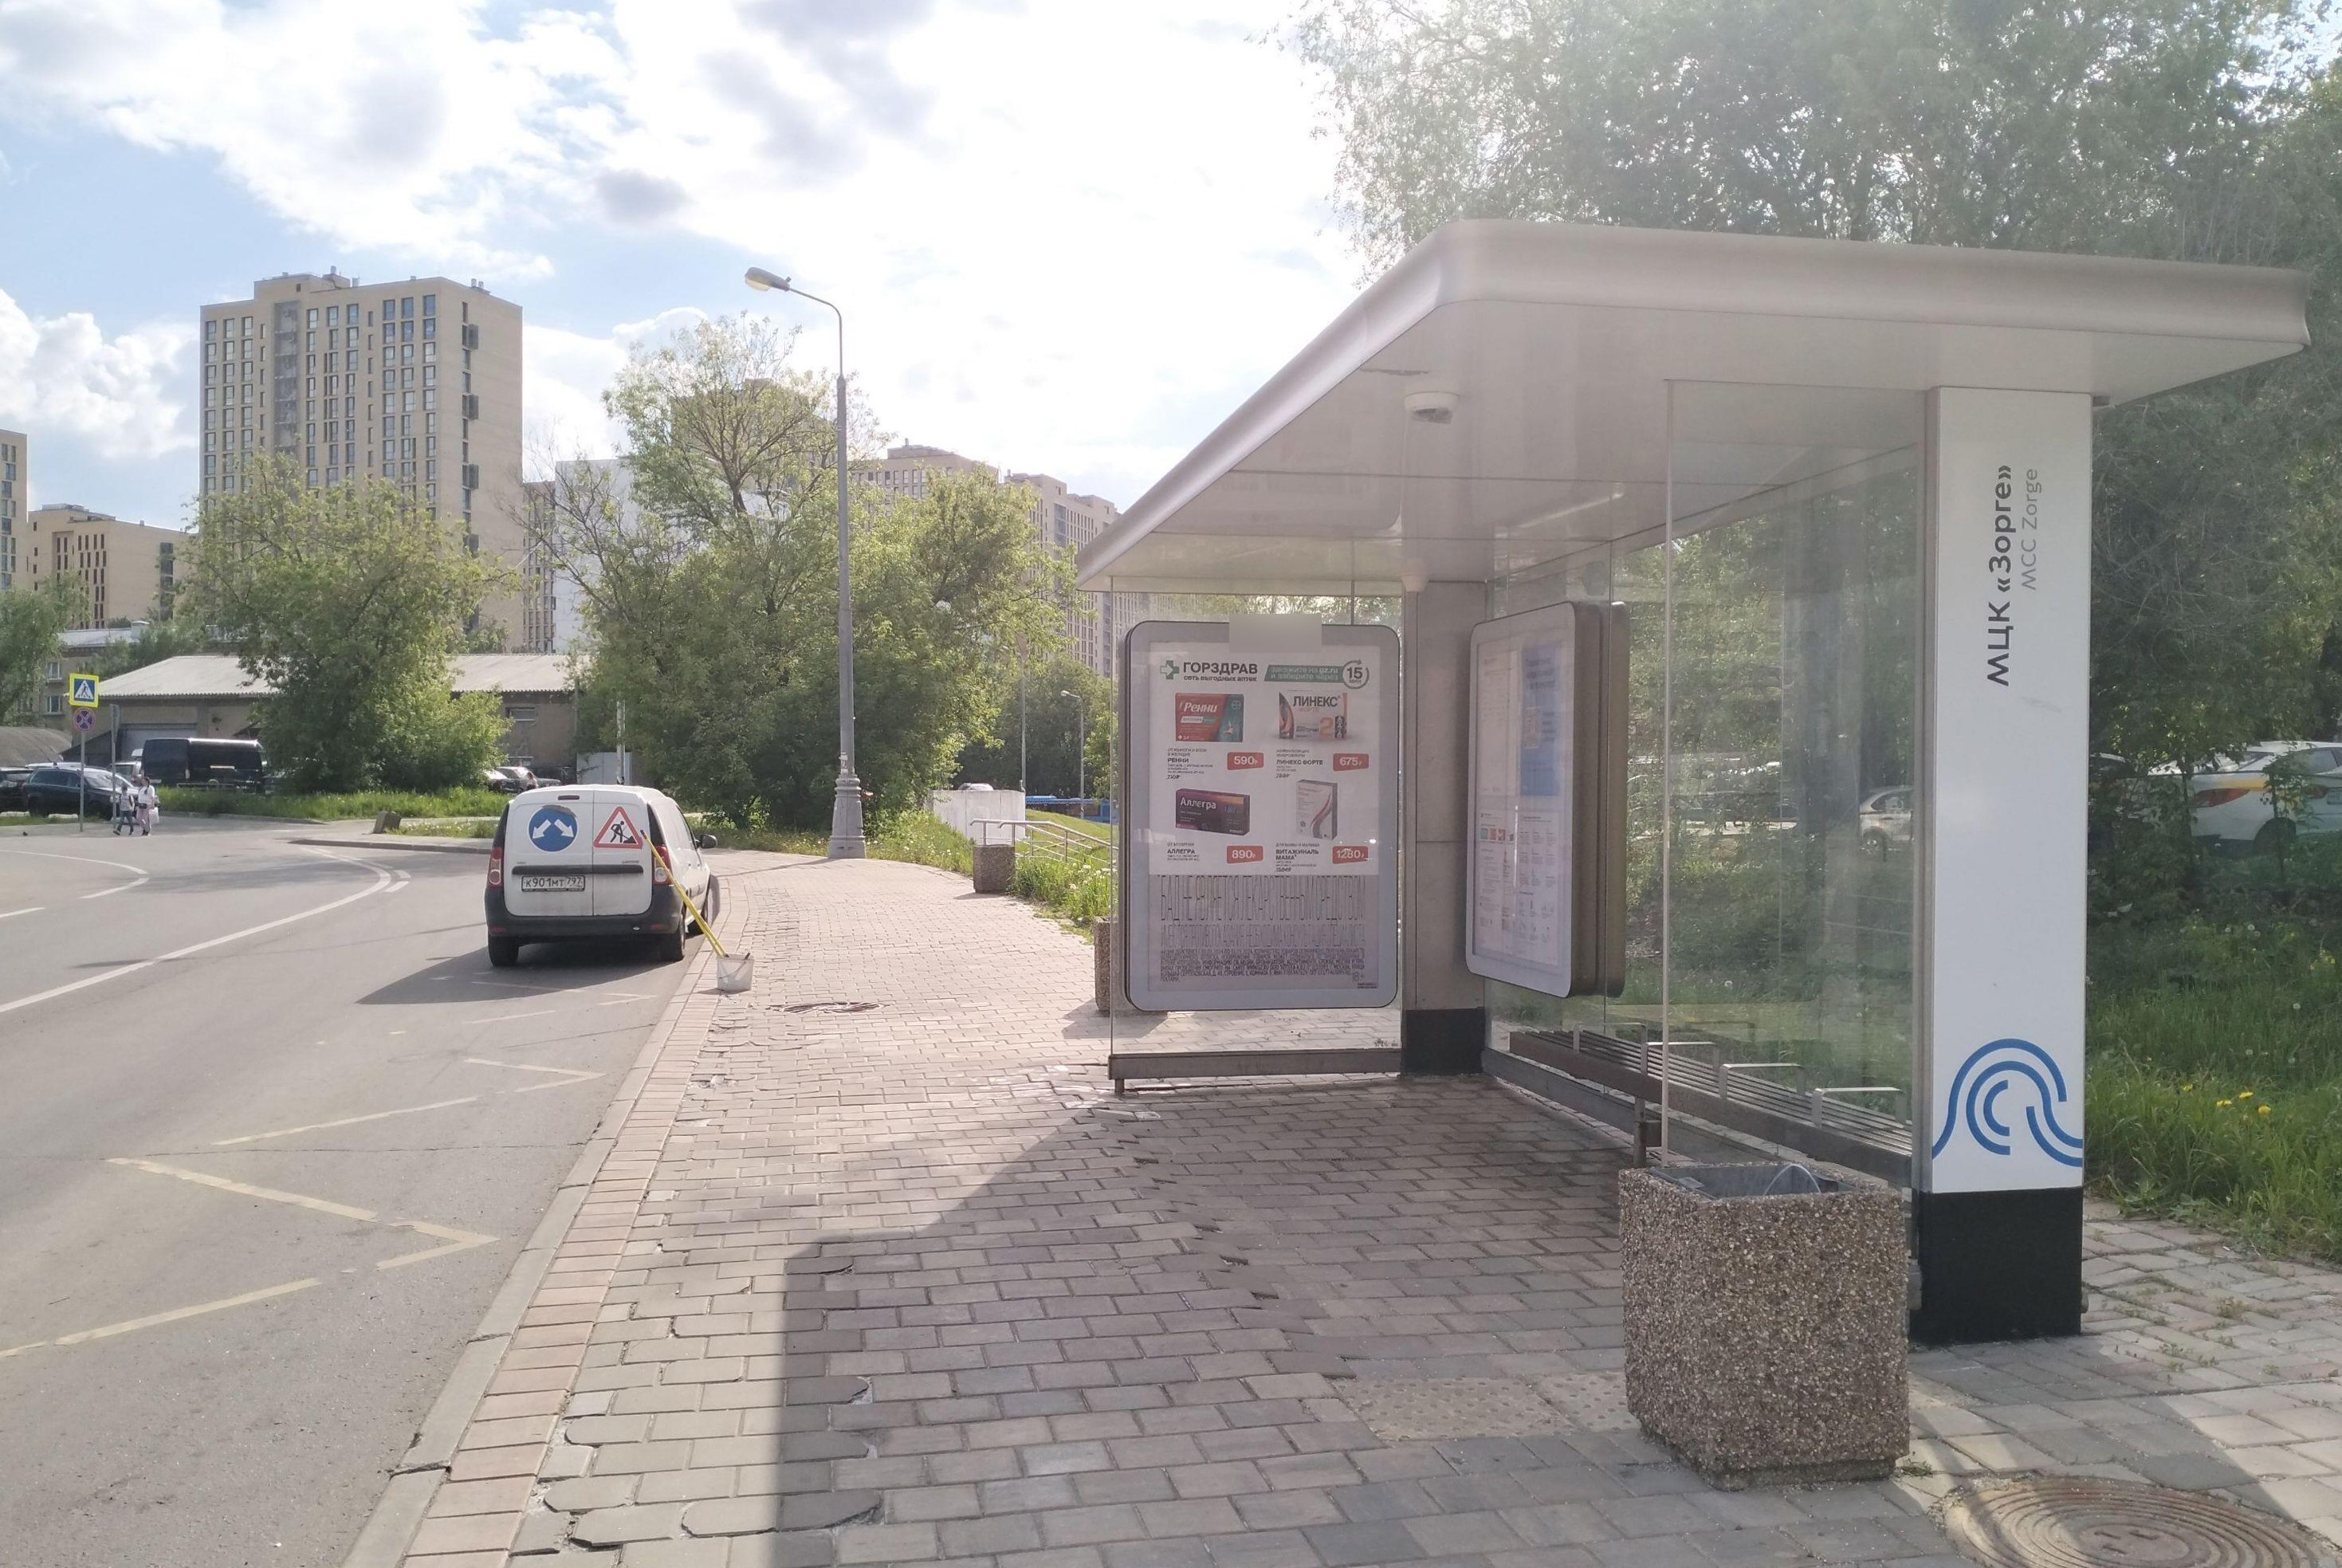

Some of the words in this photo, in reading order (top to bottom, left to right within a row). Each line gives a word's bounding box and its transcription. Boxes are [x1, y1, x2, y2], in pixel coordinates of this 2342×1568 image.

[2022, 468, 2041, 530] Zorge
[1988, 465, 2017, 592] «Зорге»
[2021, 538, 2037, 591] MCC
[1987, 601, 2014, 686] МЦК
[1183, 662, 1258, 675] ГОРЗДРАВ
[1347, 667, 1363, 679] 15
[1184, 701, 1217, 713] Ренни
[1181, 797, 1216, 811] Аллегра
